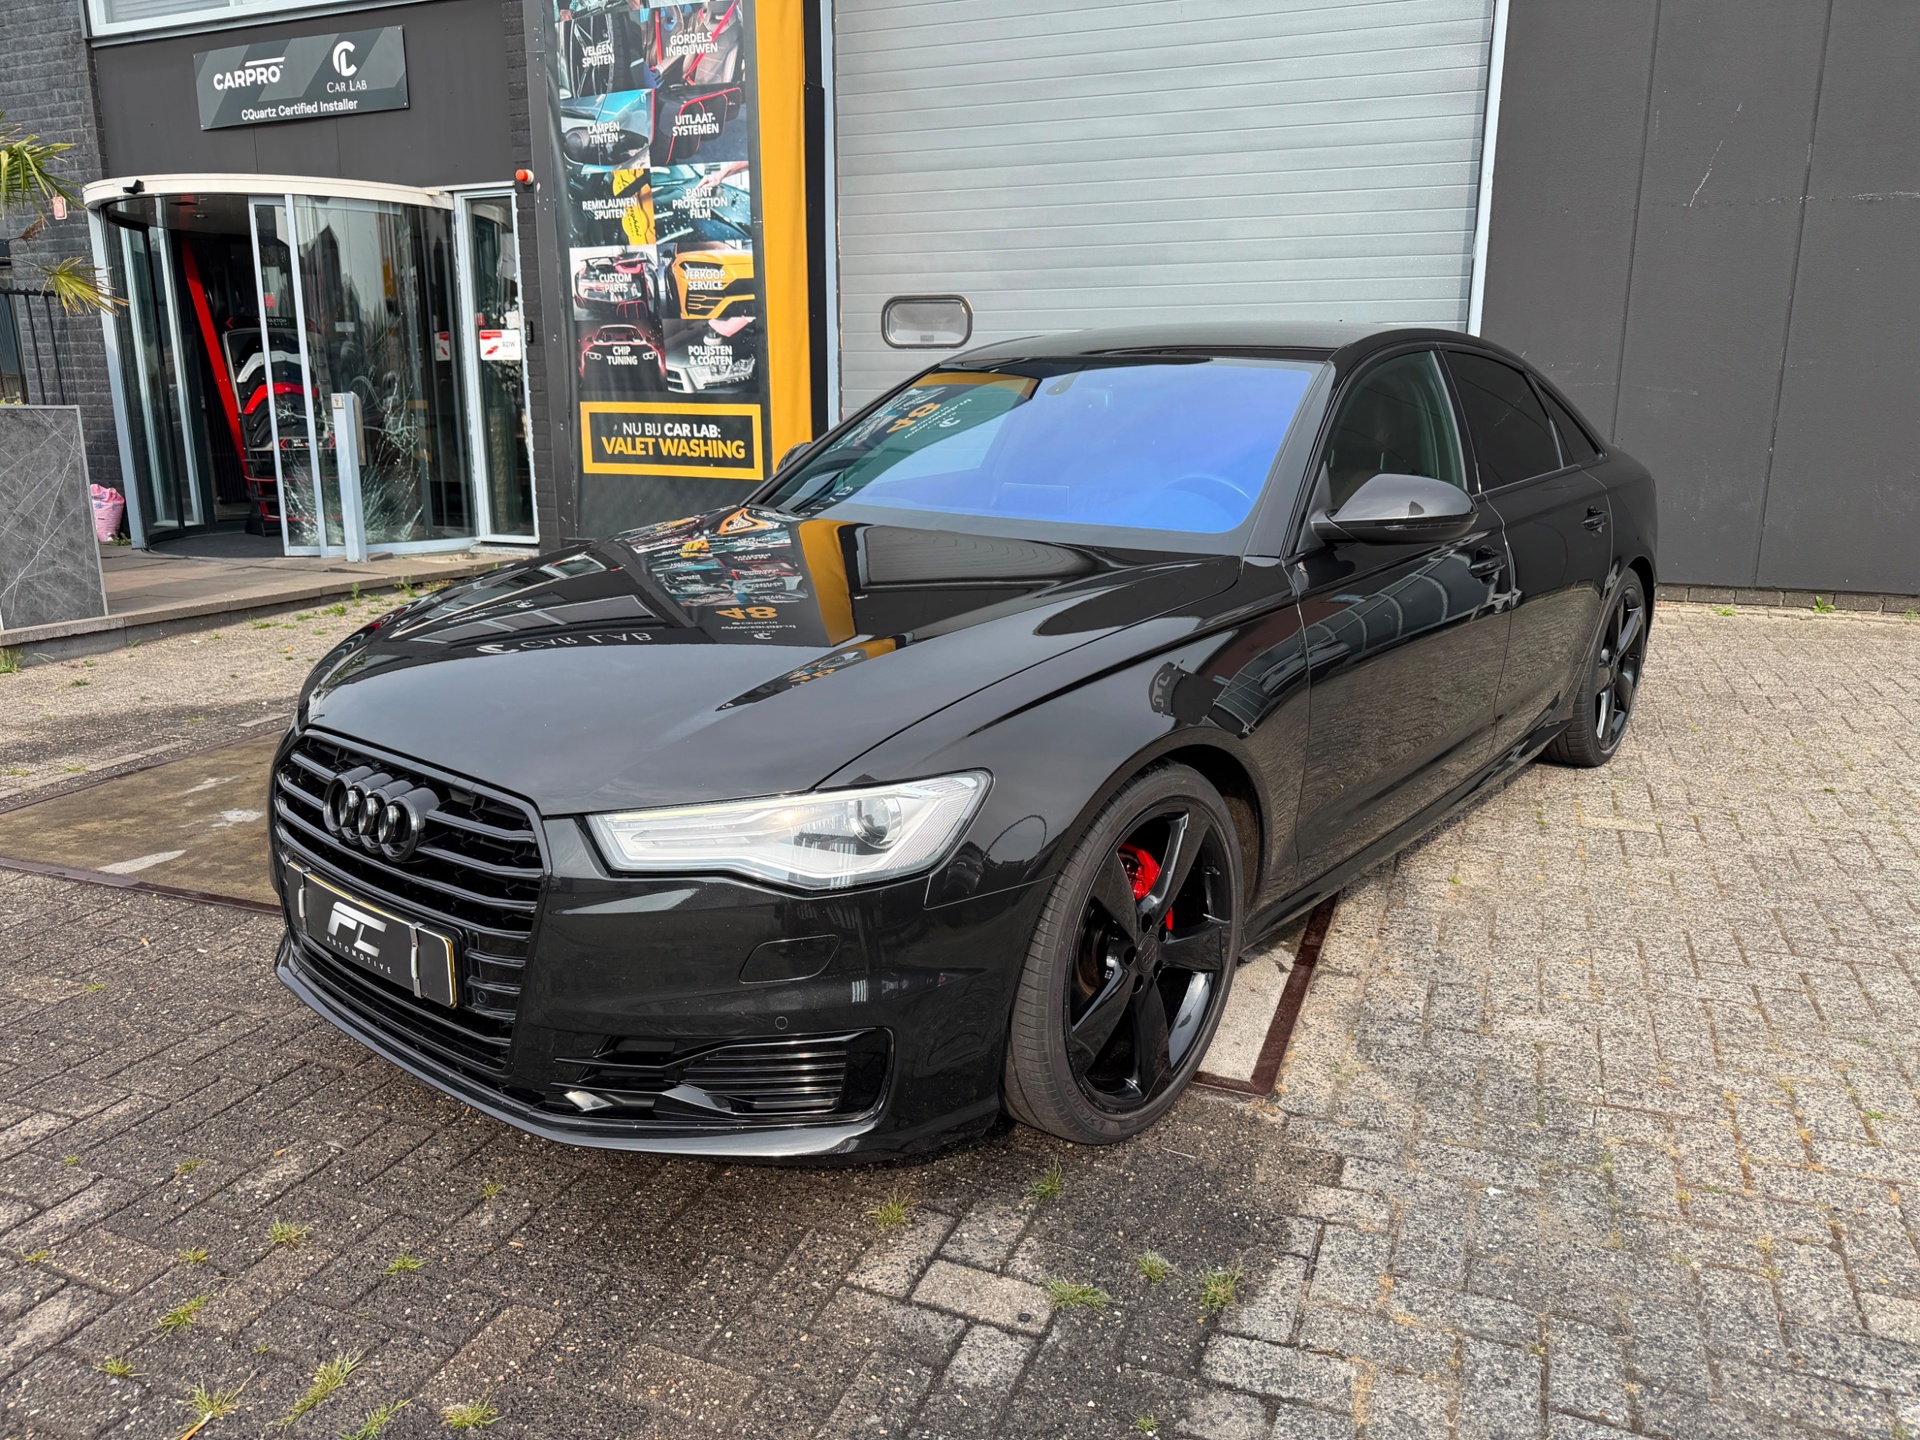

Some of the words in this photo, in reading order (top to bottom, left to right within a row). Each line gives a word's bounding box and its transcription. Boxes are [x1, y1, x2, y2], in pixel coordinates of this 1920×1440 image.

[670, 32, 713, 44] GORDELS
[582, 43, 613, 56] VELGEN
[666, 42, 718, 57] INBOUWEN
[582, 54, 615, 68] SPUITEN
[213, 66, 280, 90] CARPRO
[326, 82, 346, 93] CAR
[349, 80, 368, 92] LAB
[242, 107, 276, 120] CQuartz
[278, 101, 318, 116] Certified
[320, 98, 358, 112] Installer
[675, 112, 716, 125] UITLAAT-
[587, 122, 620, 134] LAMPEN
[672, 123, 720, 137] SYSTEMEN
[590, 132, 619, 144] TINTEN
[686, 187, 713, 198] PAINT
[582, 198, 638, 211] REMKLAUWEN
[672, 198, 728, 210] PROTECTION
[594, 208, 626, 220] SPUITEN
[690, 208, 711, 220] FILM
[599, 273, 632, 283] CUSTOM
[684, 270, 726, 280] VERKOOP
[604, 283, 629, 294] PARTS
[688, 280, 723, 291] SERVICE
[612, 346, 631, 356] CHIP
[688, 345, 732, 356] POLIJSTEN
[606, 356, 638, 366] TUNING
[698, 356, 732, 366] COATEN
[622, 422, 642, 436] NU
[644, 422, 661, 436] BIJ
[664, 424, 692, 437] CAR
[693, 424, 721, 438] LAB:
[601, 436, 656, 456] VALET
[658, 438, 746, 460] WASHING
[326, 935, 392, 974] AUTOMOTIVE
